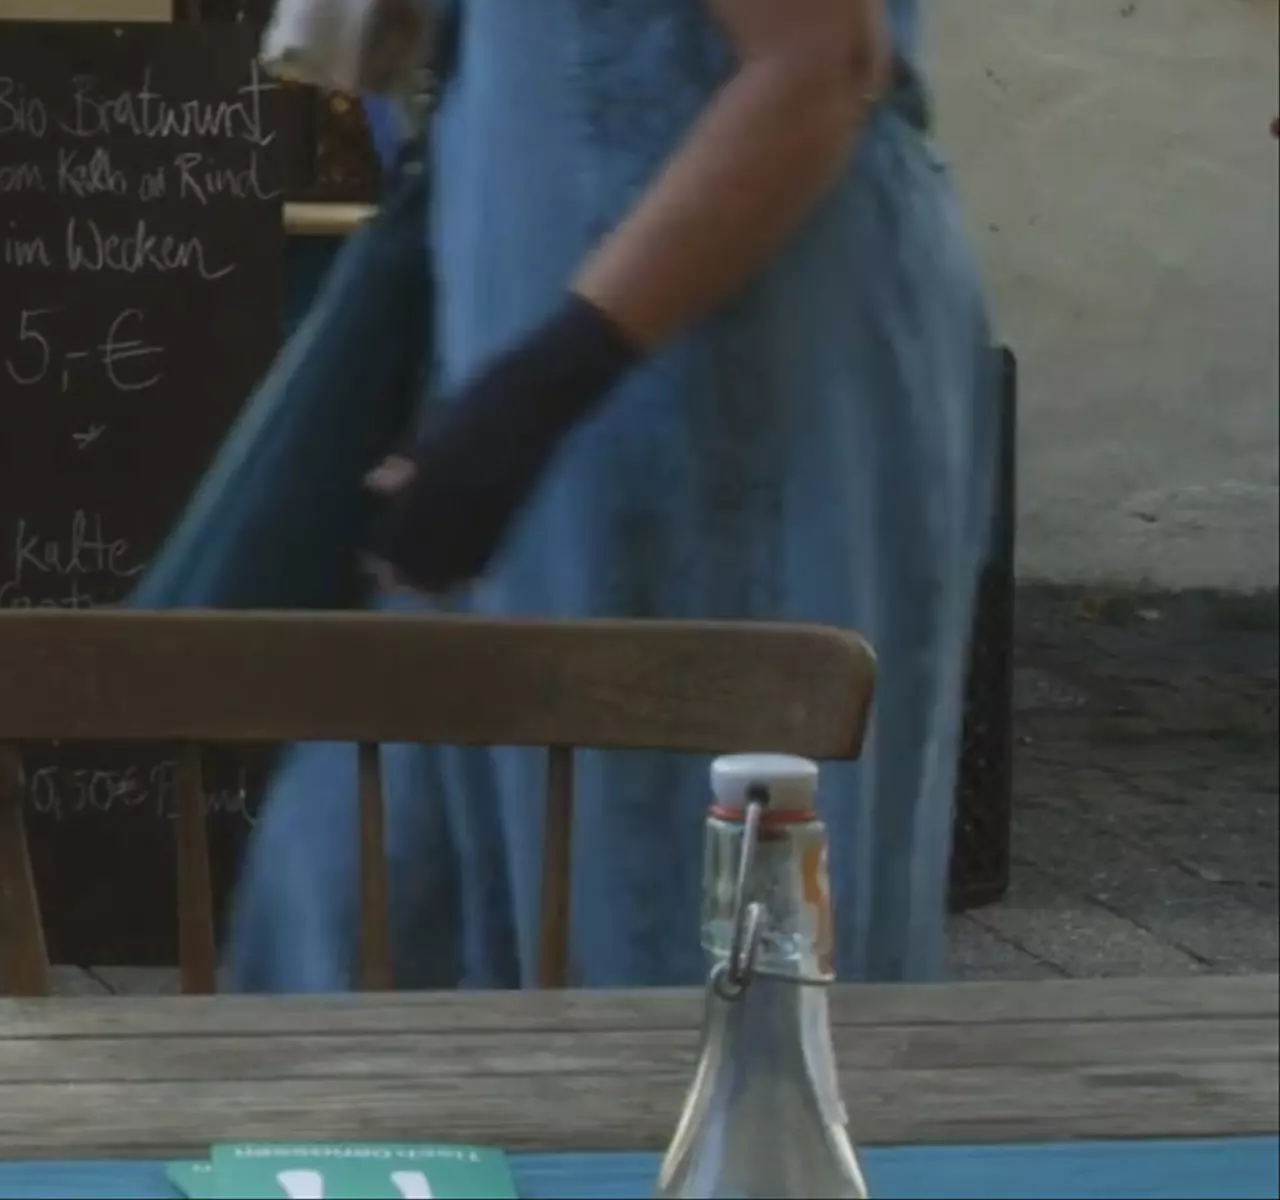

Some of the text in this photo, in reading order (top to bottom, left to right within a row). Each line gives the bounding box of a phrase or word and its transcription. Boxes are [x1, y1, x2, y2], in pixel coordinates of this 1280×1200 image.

[173, 150, 283, 206] Rind
[5, 216, 237, 280] im Wecken
